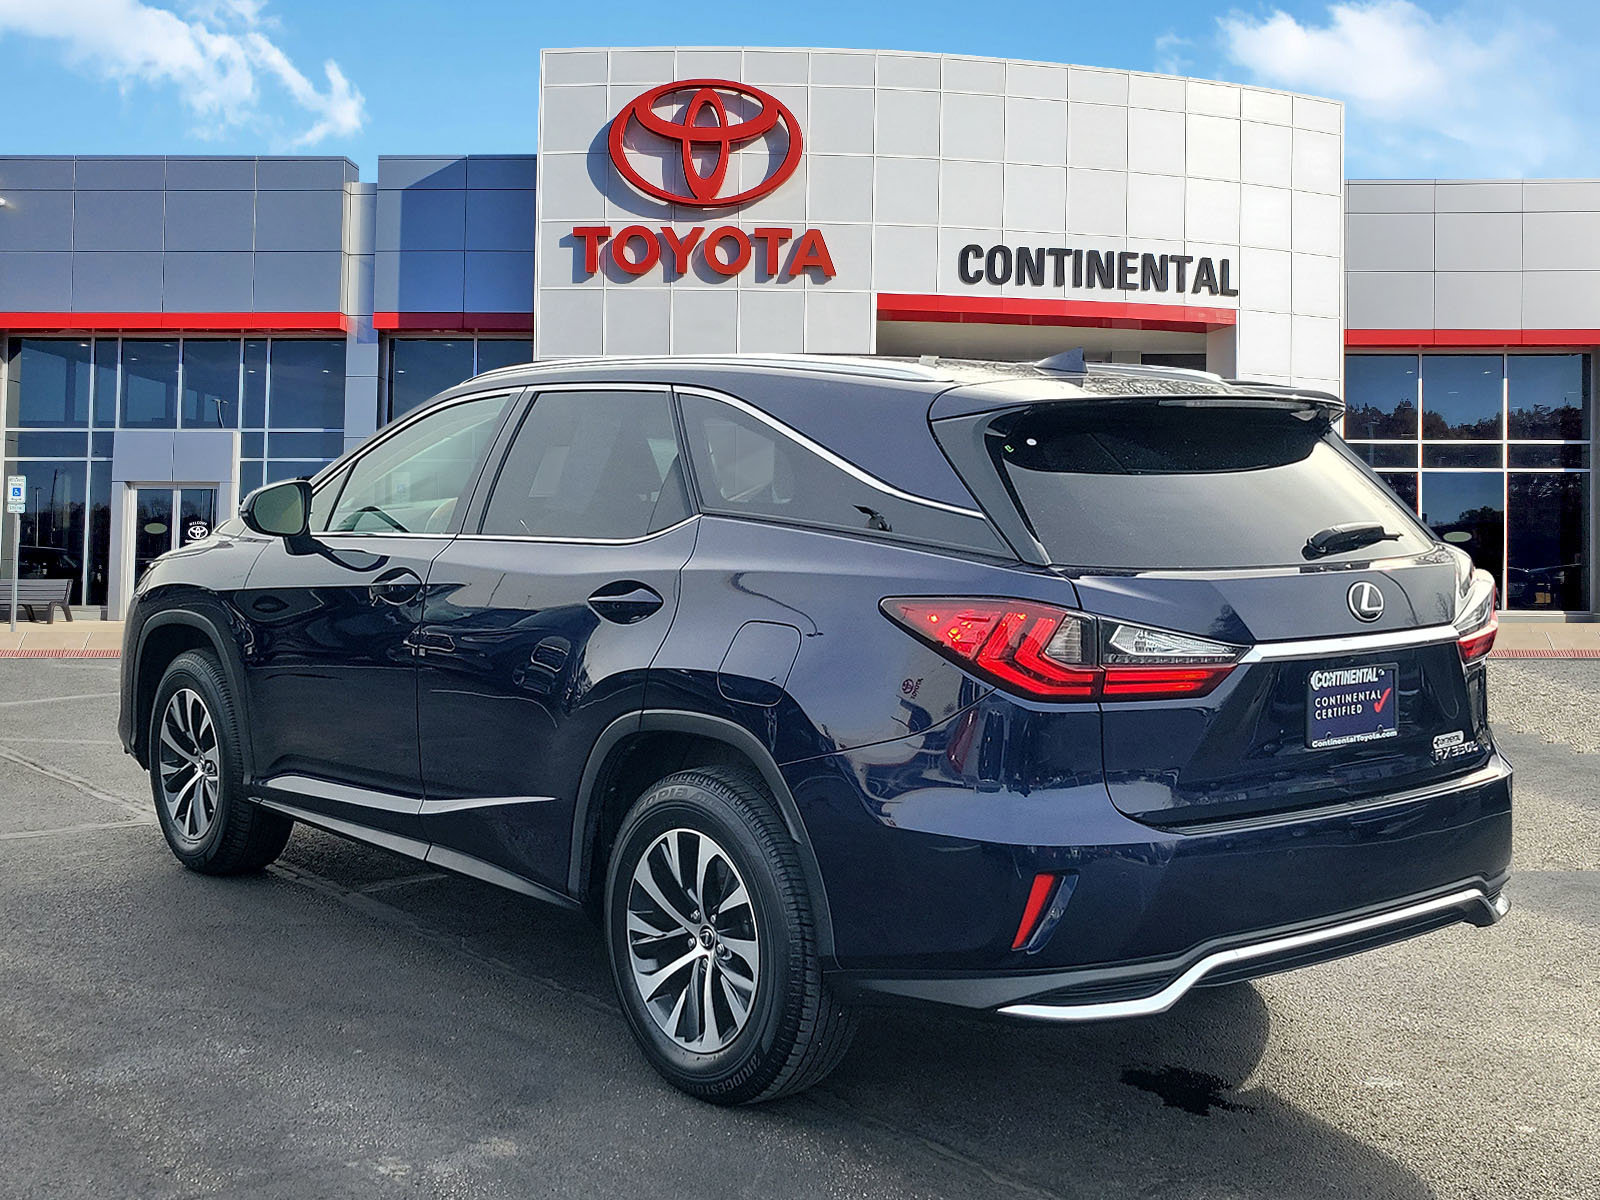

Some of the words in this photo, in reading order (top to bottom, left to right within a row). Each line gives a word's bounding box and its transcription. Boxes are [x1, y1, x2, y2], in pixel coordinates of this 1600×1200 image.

[572, 225, 837, 277] TOYOTA
[958, 244, 1239, 297] CONTINENTAL
[1310, 667, 1379, 691] CONTINENTAL
[1315, 690, 1382, 708] CONTINENTAL
[1315, 704, 1363, 720] CERTIFIED
[1311, 730, 1398, 748] ContinentalToyota.com
[688, 1053, 761, 1097] BRIDGESTO
